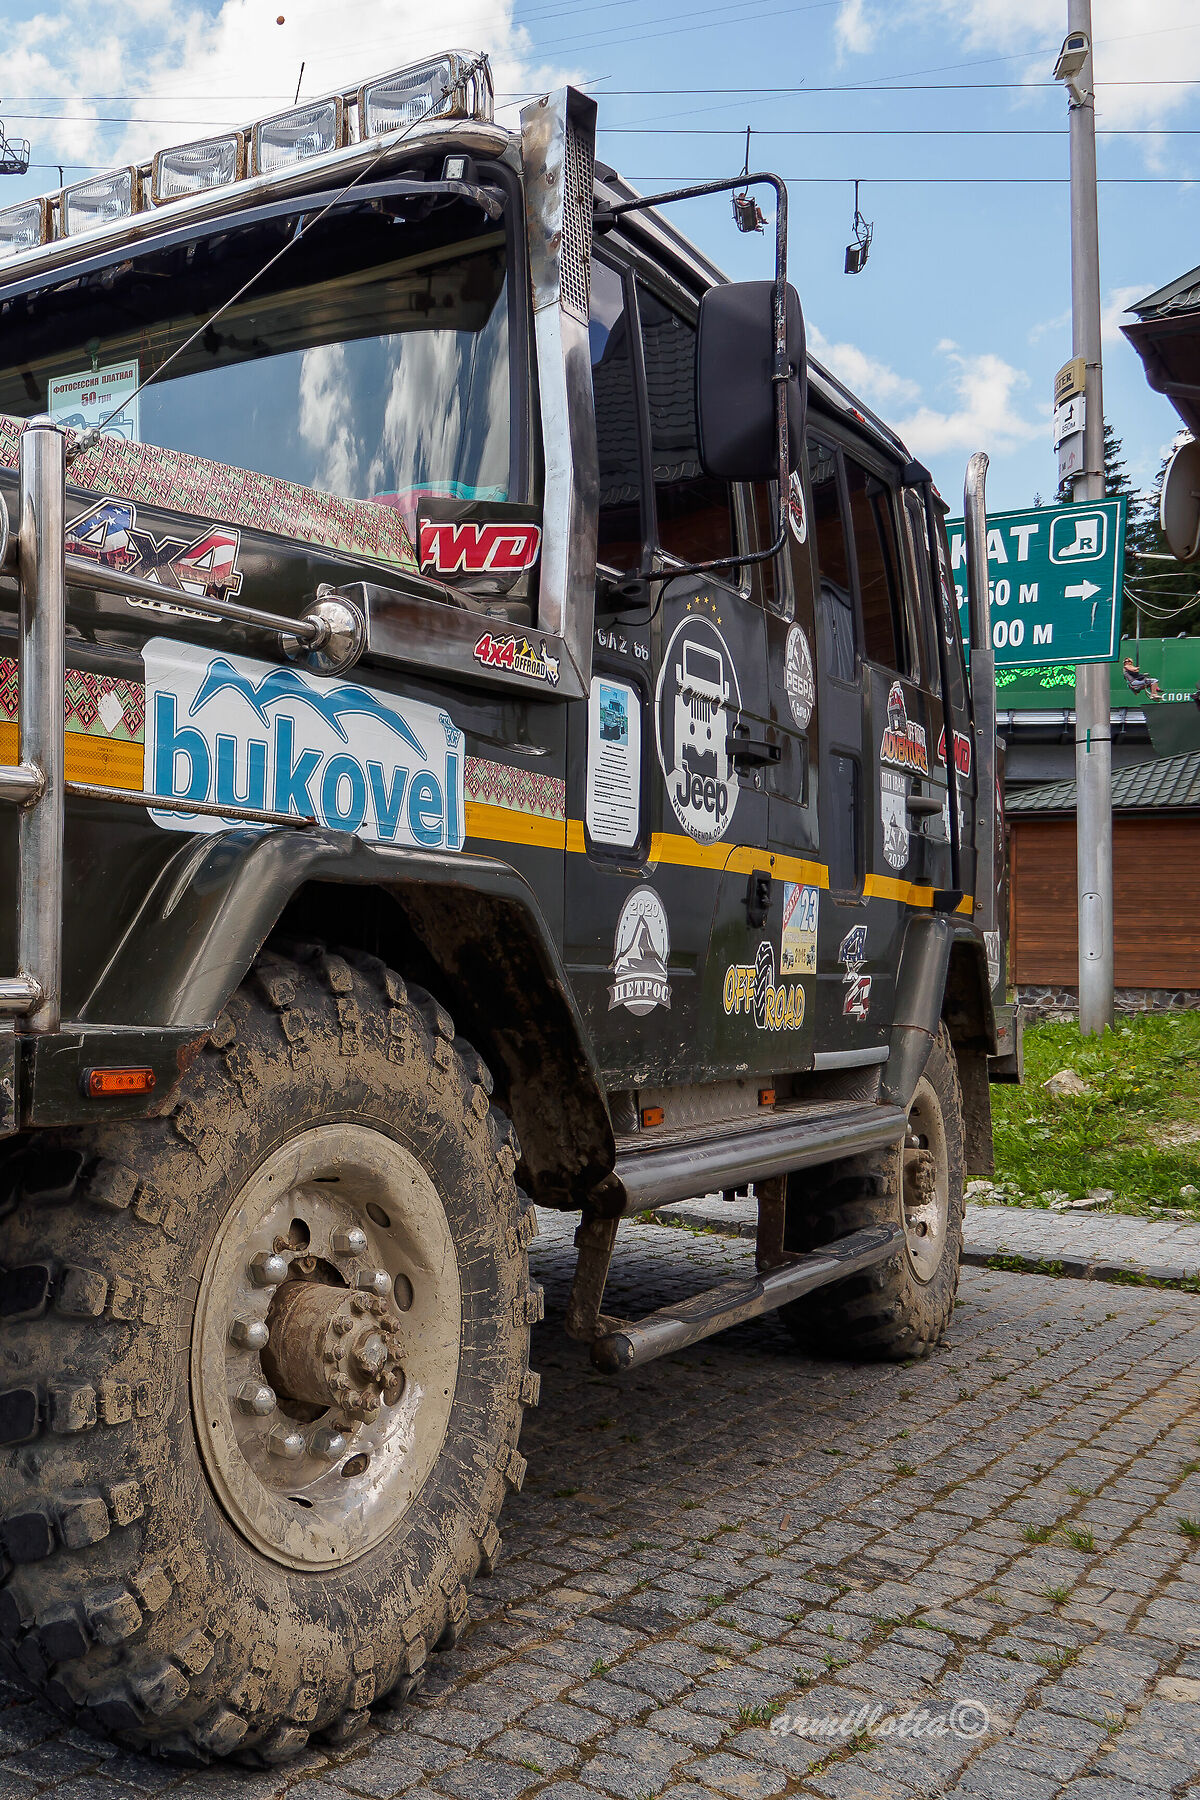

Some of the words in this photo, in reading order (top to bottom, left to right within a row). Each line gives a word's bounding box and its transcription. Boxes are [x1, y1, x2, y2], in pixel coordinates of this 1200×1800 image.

[53, 377, 99, 394] ФОТОСЕССИЯ
[102, 370, 133, 384] ПЛАТНАЯ
[81, 392, 97, 406] 50
[474, 633, 515, 669] 4x4
[514, 655, 547, 679] OFFROAD
[154, 690, 461, 850] bukovel
[676, 760, 728, 823] Jeep
[630, 899, 659, 918] 2020
[800, 889, 817, 932] 23
[613, 980, 669, 1003] ПЕТРОС
[723, 964, 757, 1015] OFF
[765, 984, 806, 1031] ROAD
